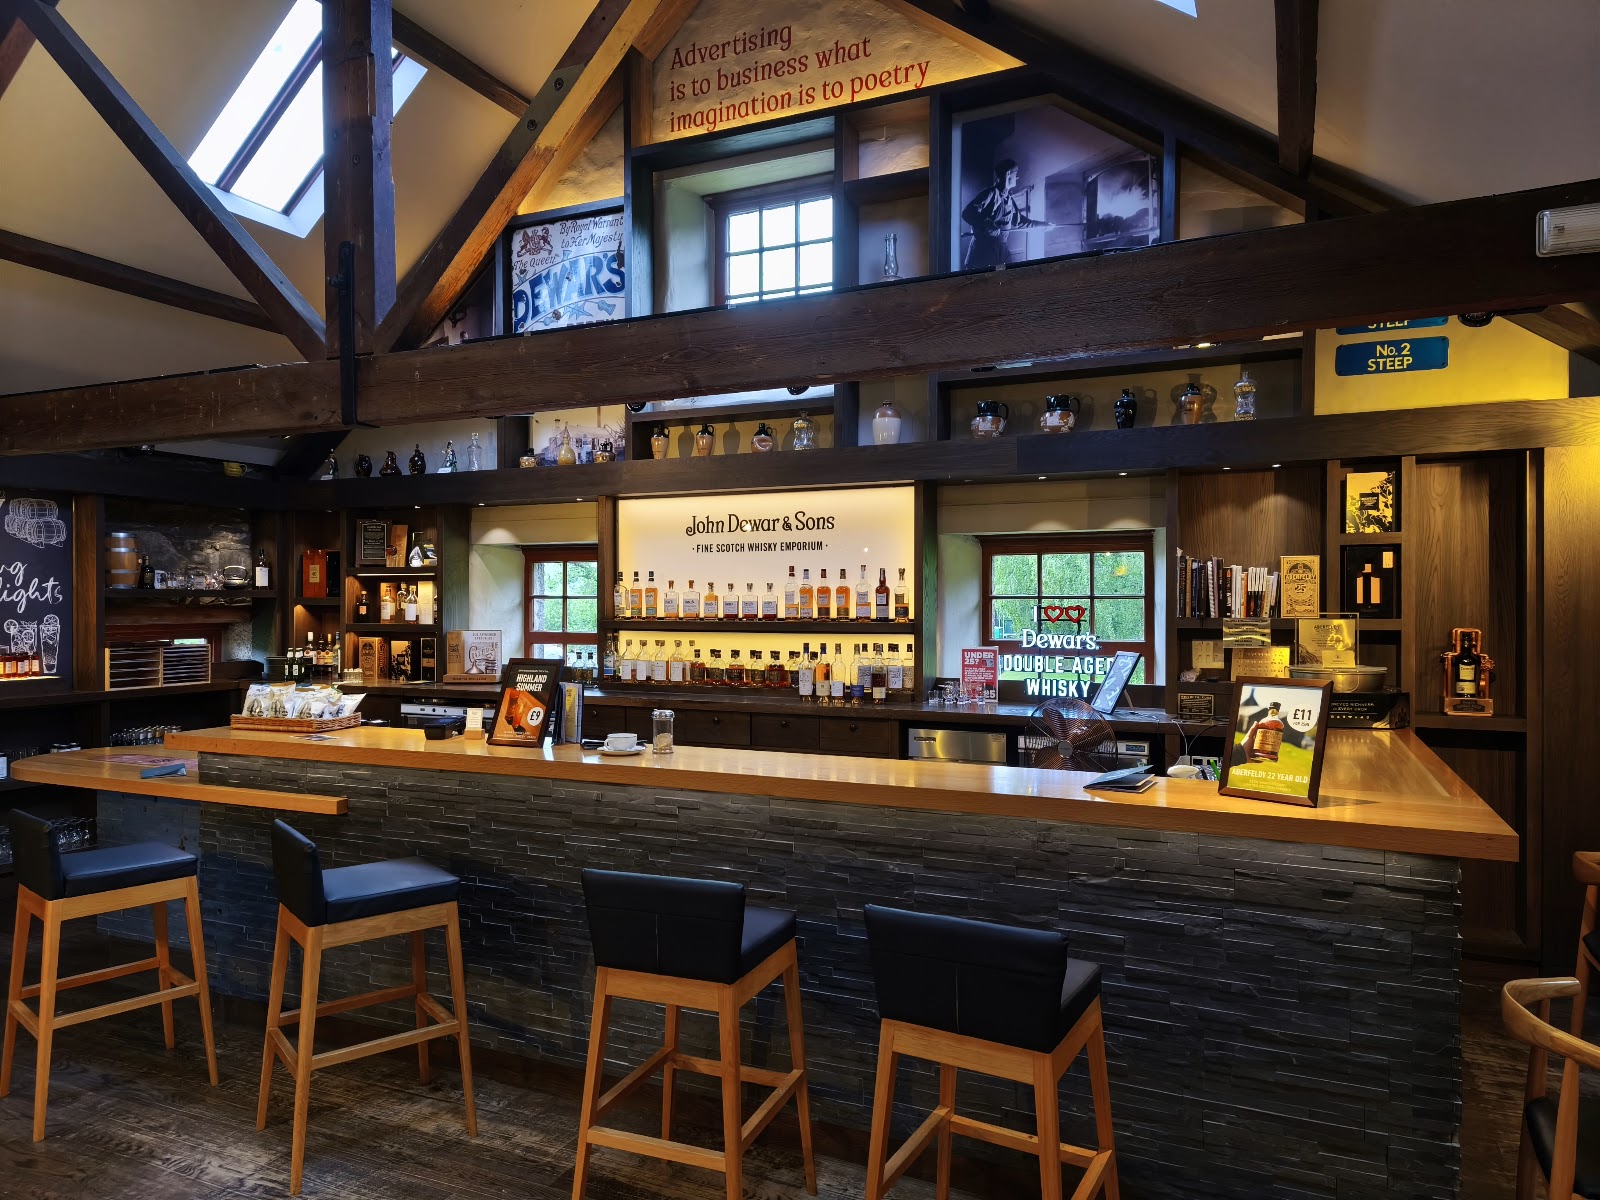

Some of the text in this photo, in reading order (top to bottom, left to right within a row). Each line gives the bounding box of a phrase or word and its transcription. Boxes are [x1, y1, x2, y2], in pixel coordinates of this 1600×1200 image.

[669, 25, 793, 70] Advertising
[669, 37, 872, 101] is to business what
[669, 60, 931, 133] imagination is to poetry
[560, 216, 624, 236] By Royal Warrant
[561, 231, 623, 249] to Her Majesty
[513, 259, 529, 271] The
[1376, 343, 1411, 357] No. 2
[1367, 356, 1413, 371] STEEP
[685, 510, 835, 536] John Dewar & Sons
[696, 540, 823, 553] FINE SCOTCH WHISKY EMPORIUM
[0, 576, 63, 614] ights
[1033, 605, 1038, 623] I
[964, 651, 995, 659] UNDER
[1003, 654, 1065, 673] DOUBLE
[516, 674, 547, 683] HIGHLAND
[516, 683, 542, 691] SUMMER
[1026, 679, 1090, 698] WHISKY
[530, 710, 541, 720] £9
[1292, 708, 1312, 721] £11
[1232, 768, 1309, 784] ABERFELDY 22 YEAR OLD
